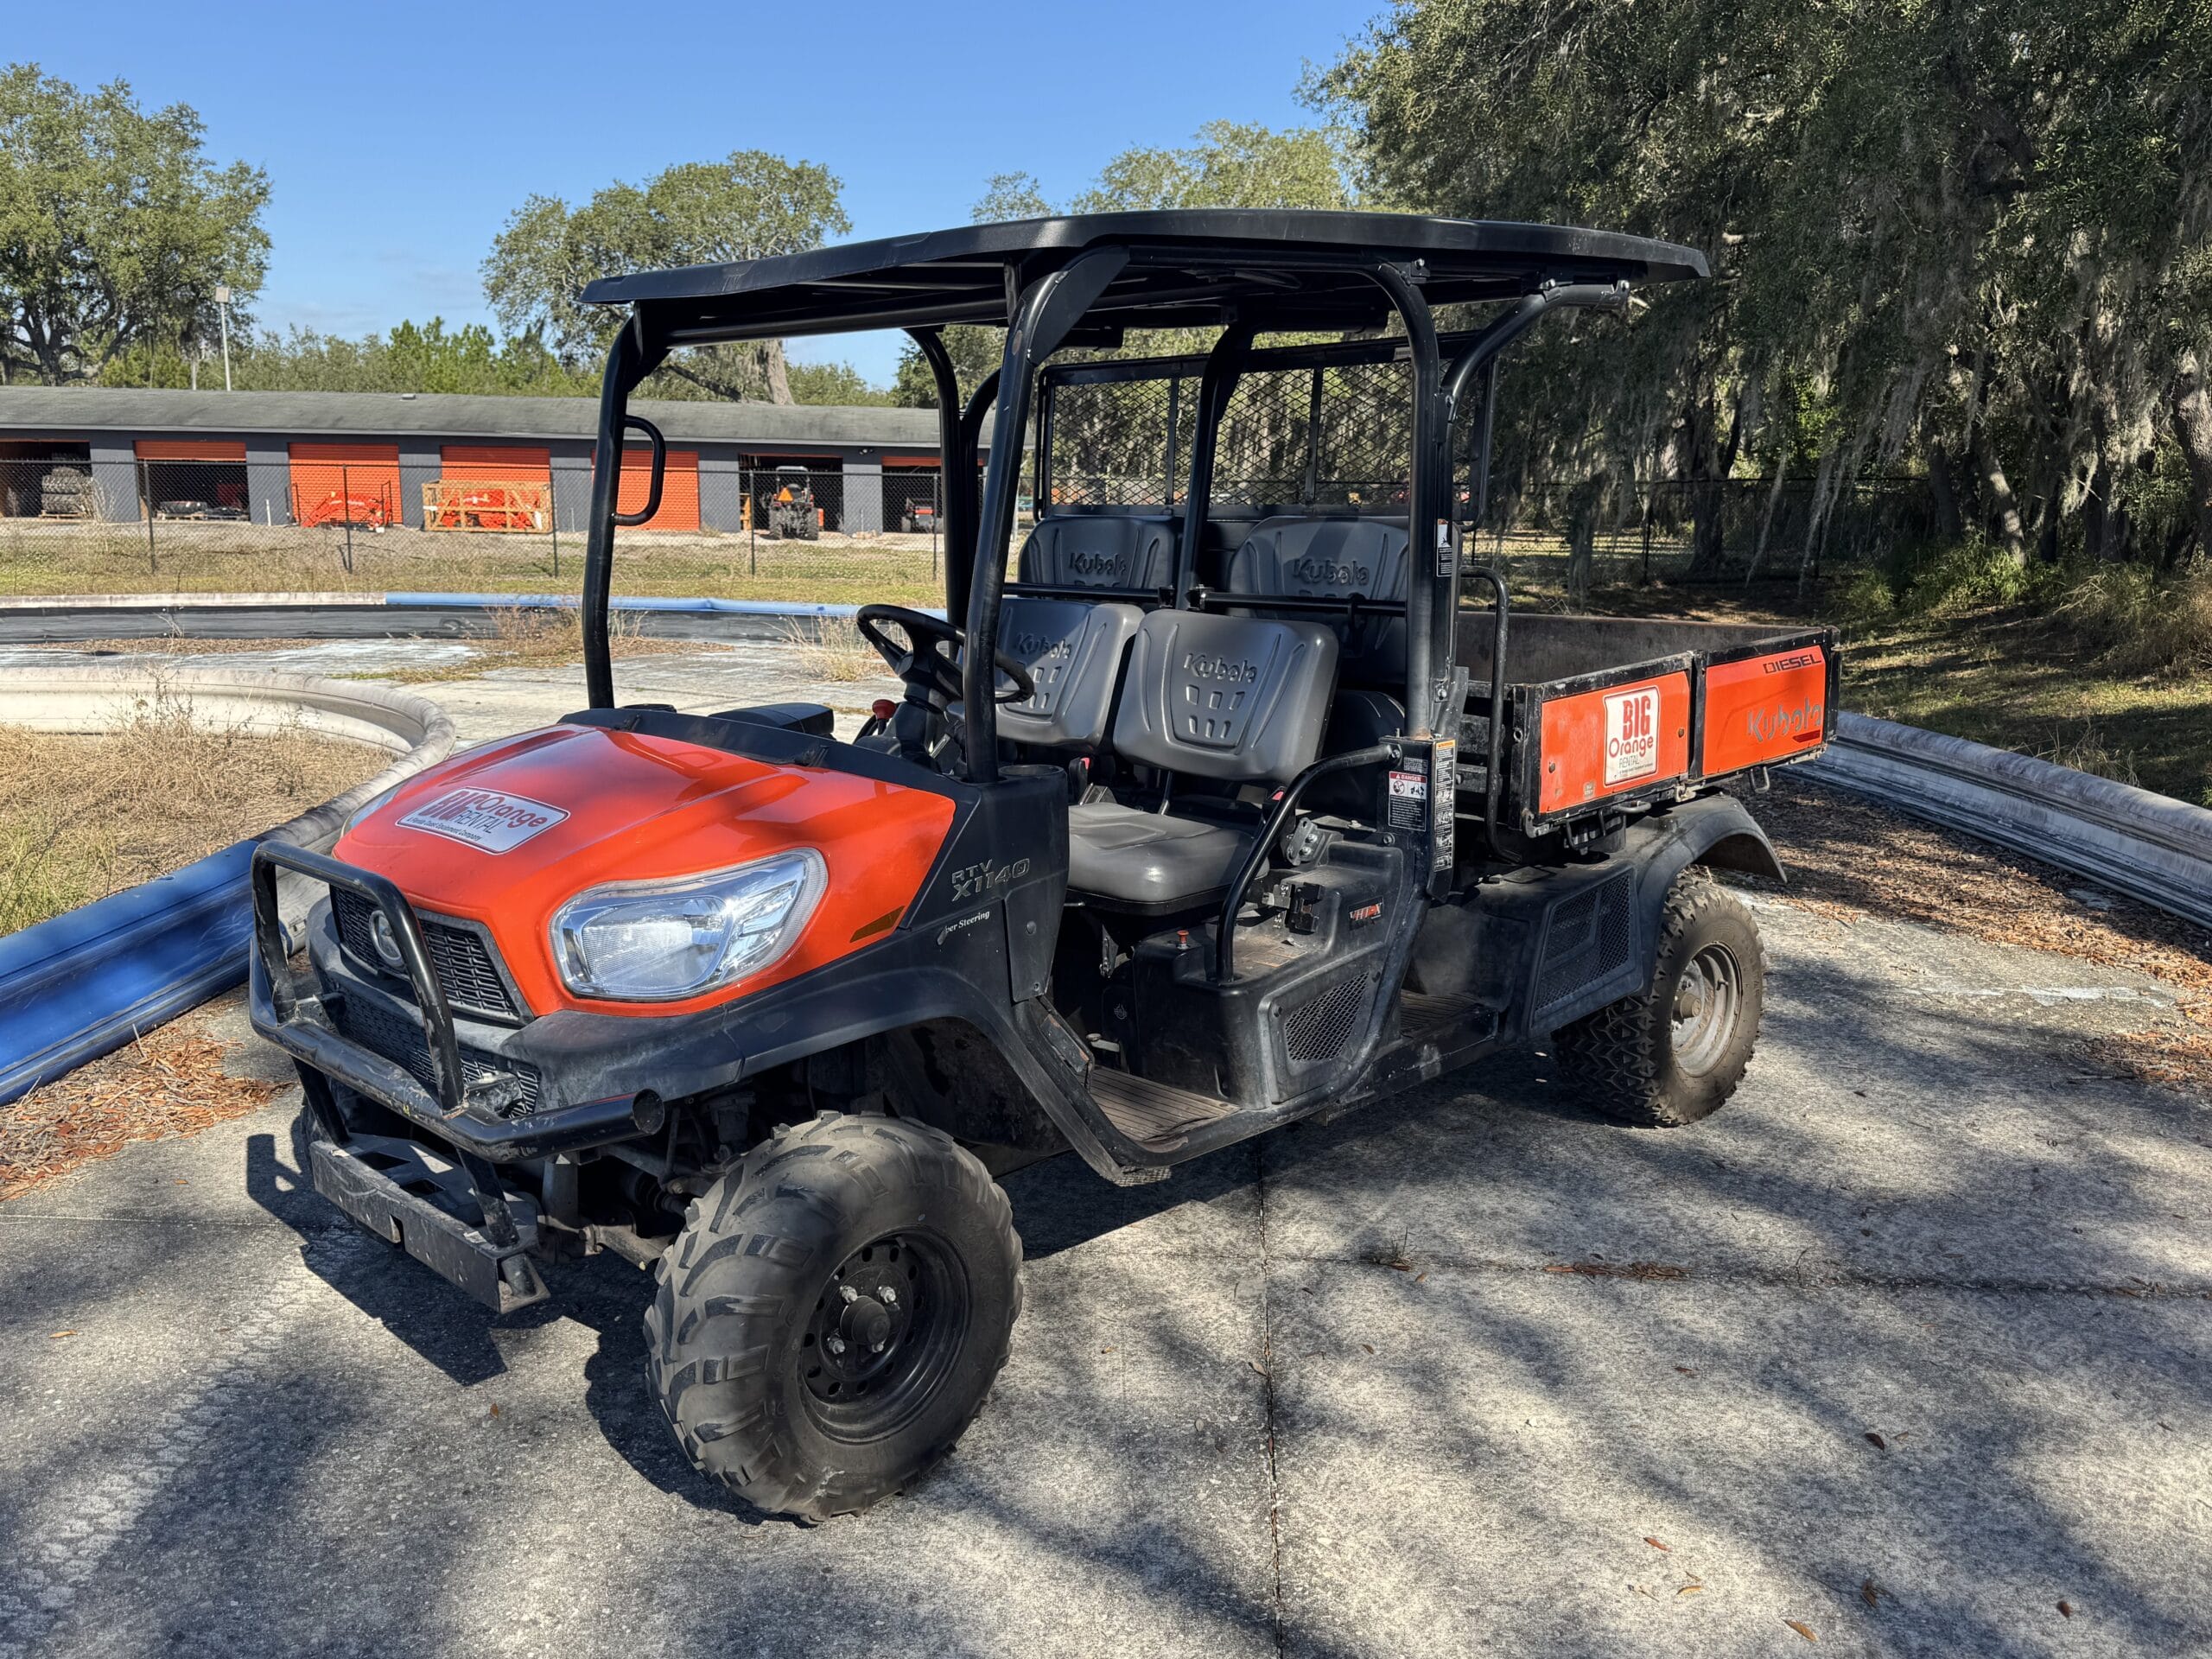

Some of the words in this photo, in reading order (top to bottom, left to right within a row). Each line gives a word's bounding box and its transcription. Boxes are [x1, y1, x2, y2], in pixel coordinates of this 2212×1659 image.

[1068, 551, 1127, 576] Kubota
[1292, 558, 1370, 586] Kubota
[1016, 632, 1073, 659] Kubota
[1183, 652, 1257, 683] Kubota
[1763, 654, 1822, 674] DIESEL
[1623, 695, 1651, 741] BIG
[1746, 696, 1821, 743] Kubota
[1609, 735, 1654, 758] Orange
[418, 790, 491, 822] BIG
[475, 796, 548, 829] Orange
[454, 810, 505, 834] RENTAL
[951, 859, 993, 884] RTV
[951, 857, 1030, 902] X1140
[958, 911, 990, 930] Steering
